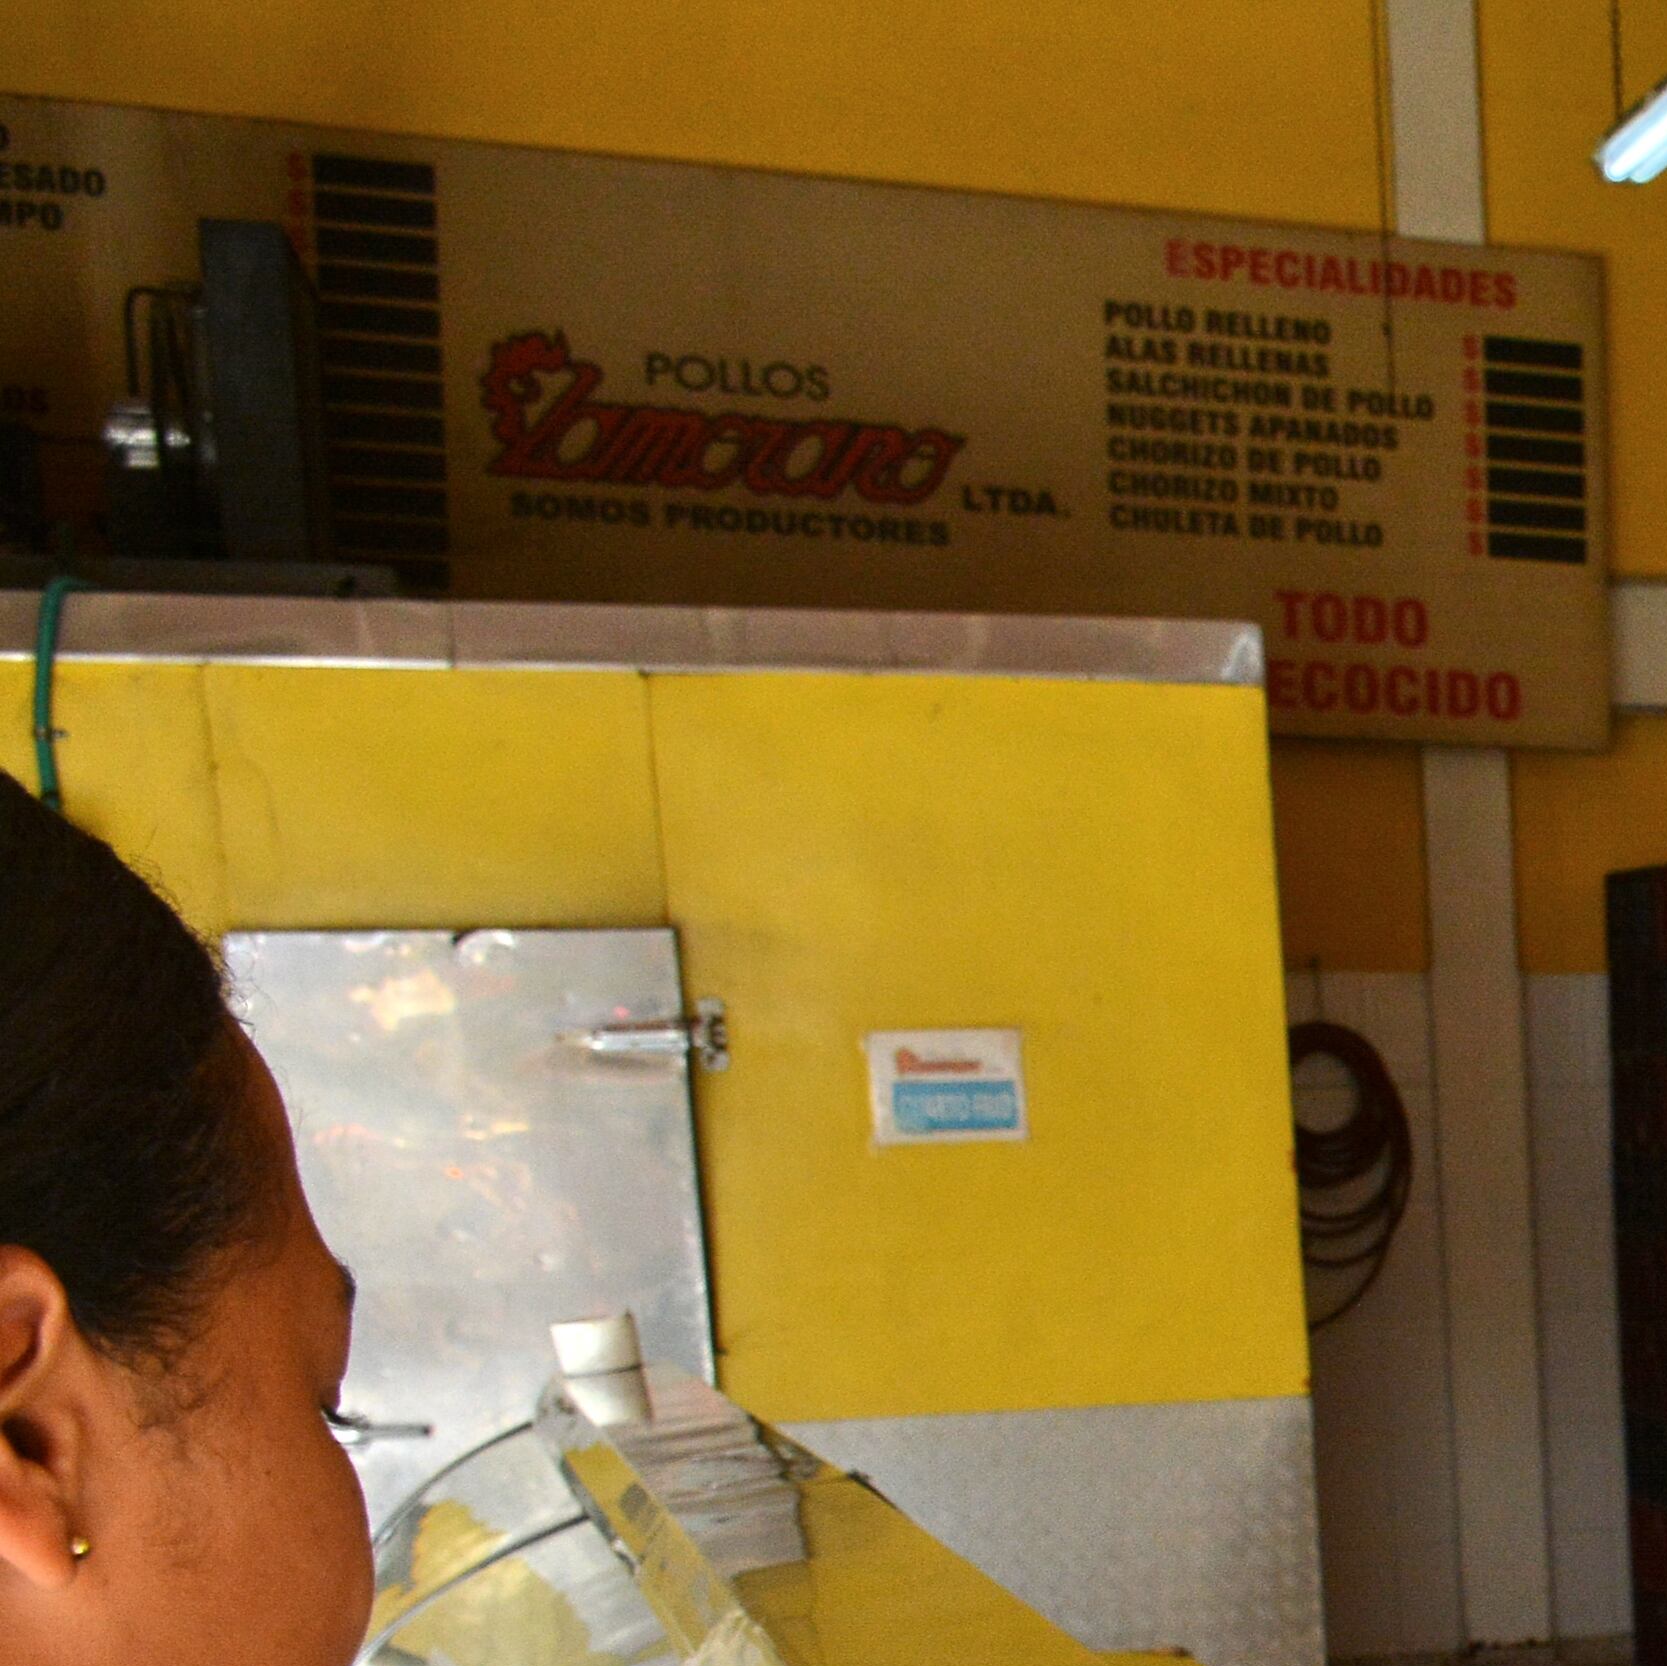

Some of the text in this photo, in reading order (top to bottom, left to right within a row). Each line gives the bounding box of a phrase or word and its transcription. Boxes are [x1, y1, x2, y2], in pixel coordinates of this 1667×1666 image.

[1164, 238, 1517, 310] ESPECIALIDADES
[1104, 299, 1332, 345] POLLO RELLENO
[643, 350, 832, 401] POLLOS
[1105, 334, 1331, 380] ALAS RELLENAS
[1105, 402, 1398, 451] NUGGETS APANADOS
[1300, 384, 1336, 412] DE
[1346, 389, 1435, 421] POLLO
[1106, 434, 1382, 482] CHORIZO DE POLLO
[1106, 468, 1340, 511] CHORIZO MIXTO
[510, 489, 951, 547] SOMOS PRODUCTORES
[1108, 503, 1385, 547] CHULETA DE POLLO
[1273, 588, 1429, 649] TODO
